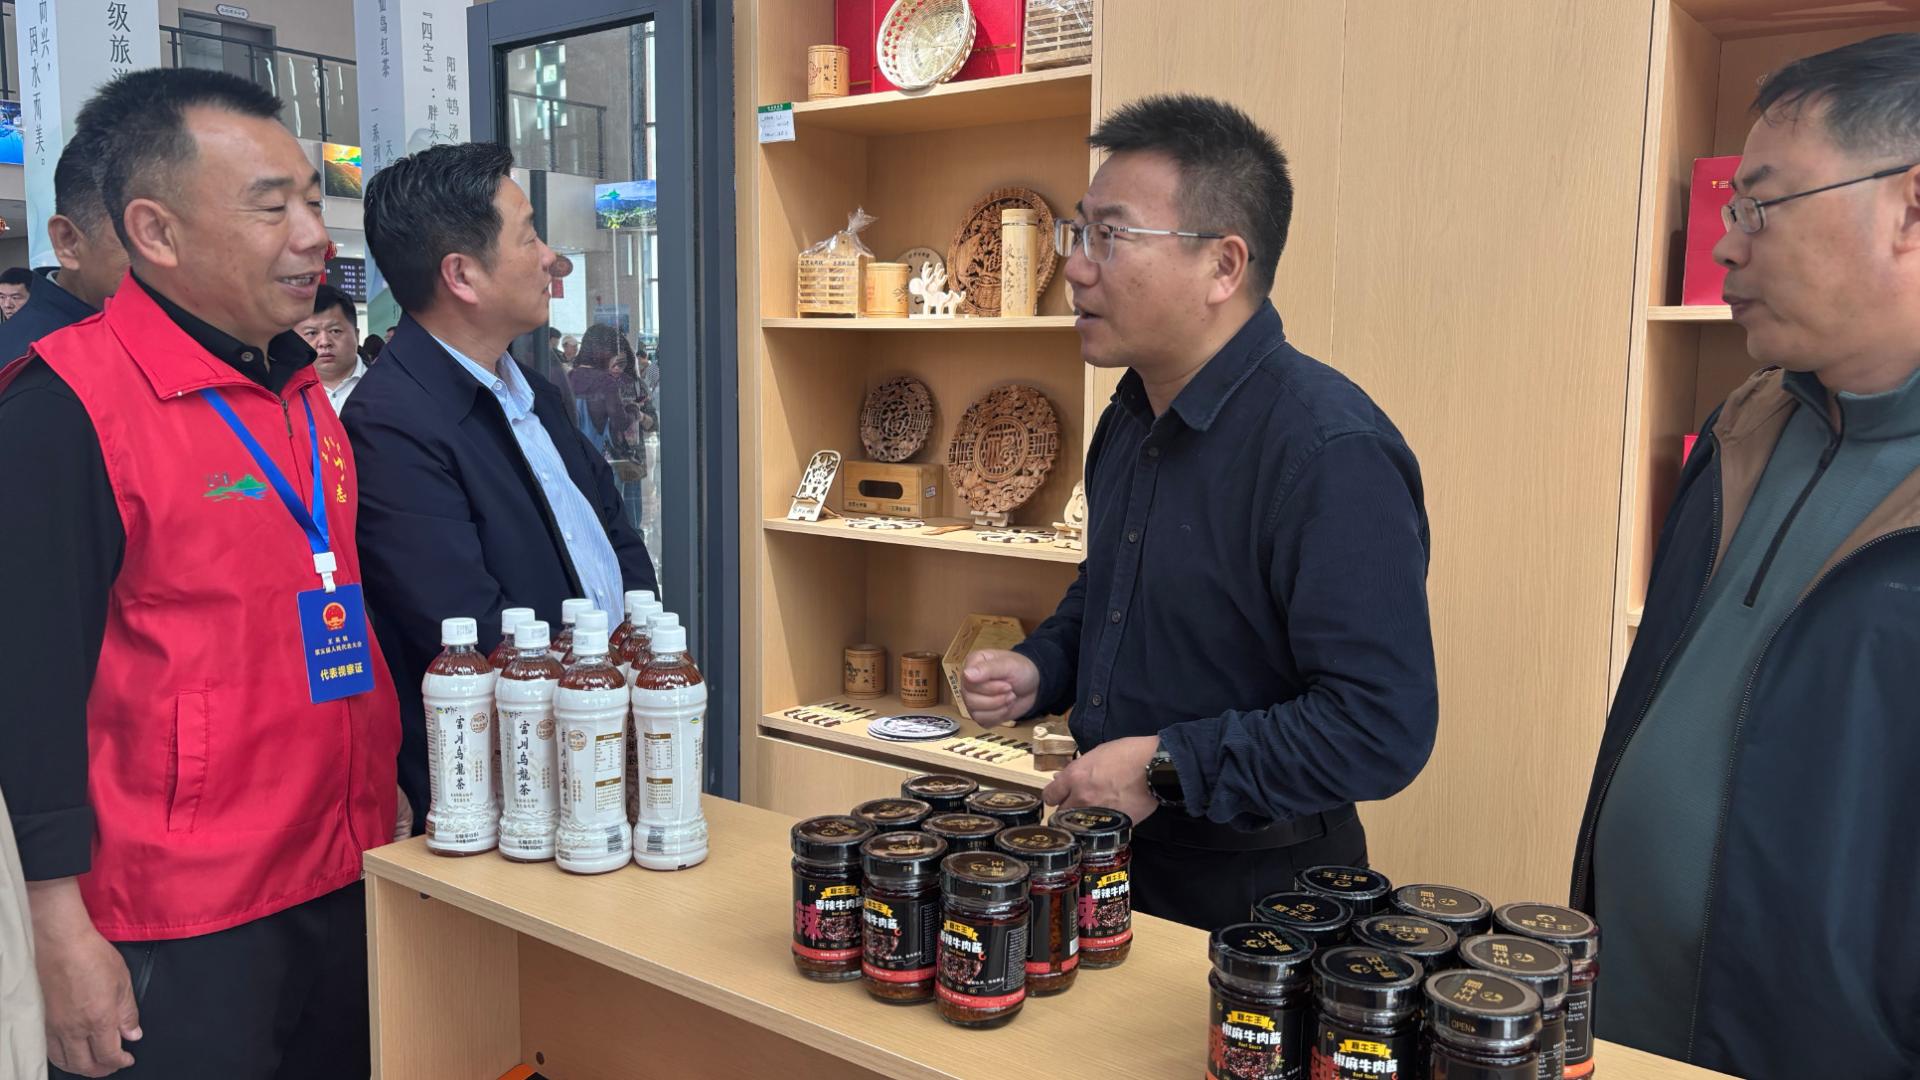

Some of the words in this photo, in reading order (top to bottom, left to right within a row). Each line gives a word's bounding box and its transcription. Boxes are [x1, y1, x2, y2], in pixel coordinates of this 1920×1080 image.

[422, 11, 439, 147] 『四宝』：胖头
[320, 662, 364, 681] 代表视察证
[1222, 1022, 1282, 1045] 椒麻牛肉酱
[1451, 1019, 1471, 1033] OPEN
[1333, 1052, 1398, 1073] 椒麻牛肉酱
